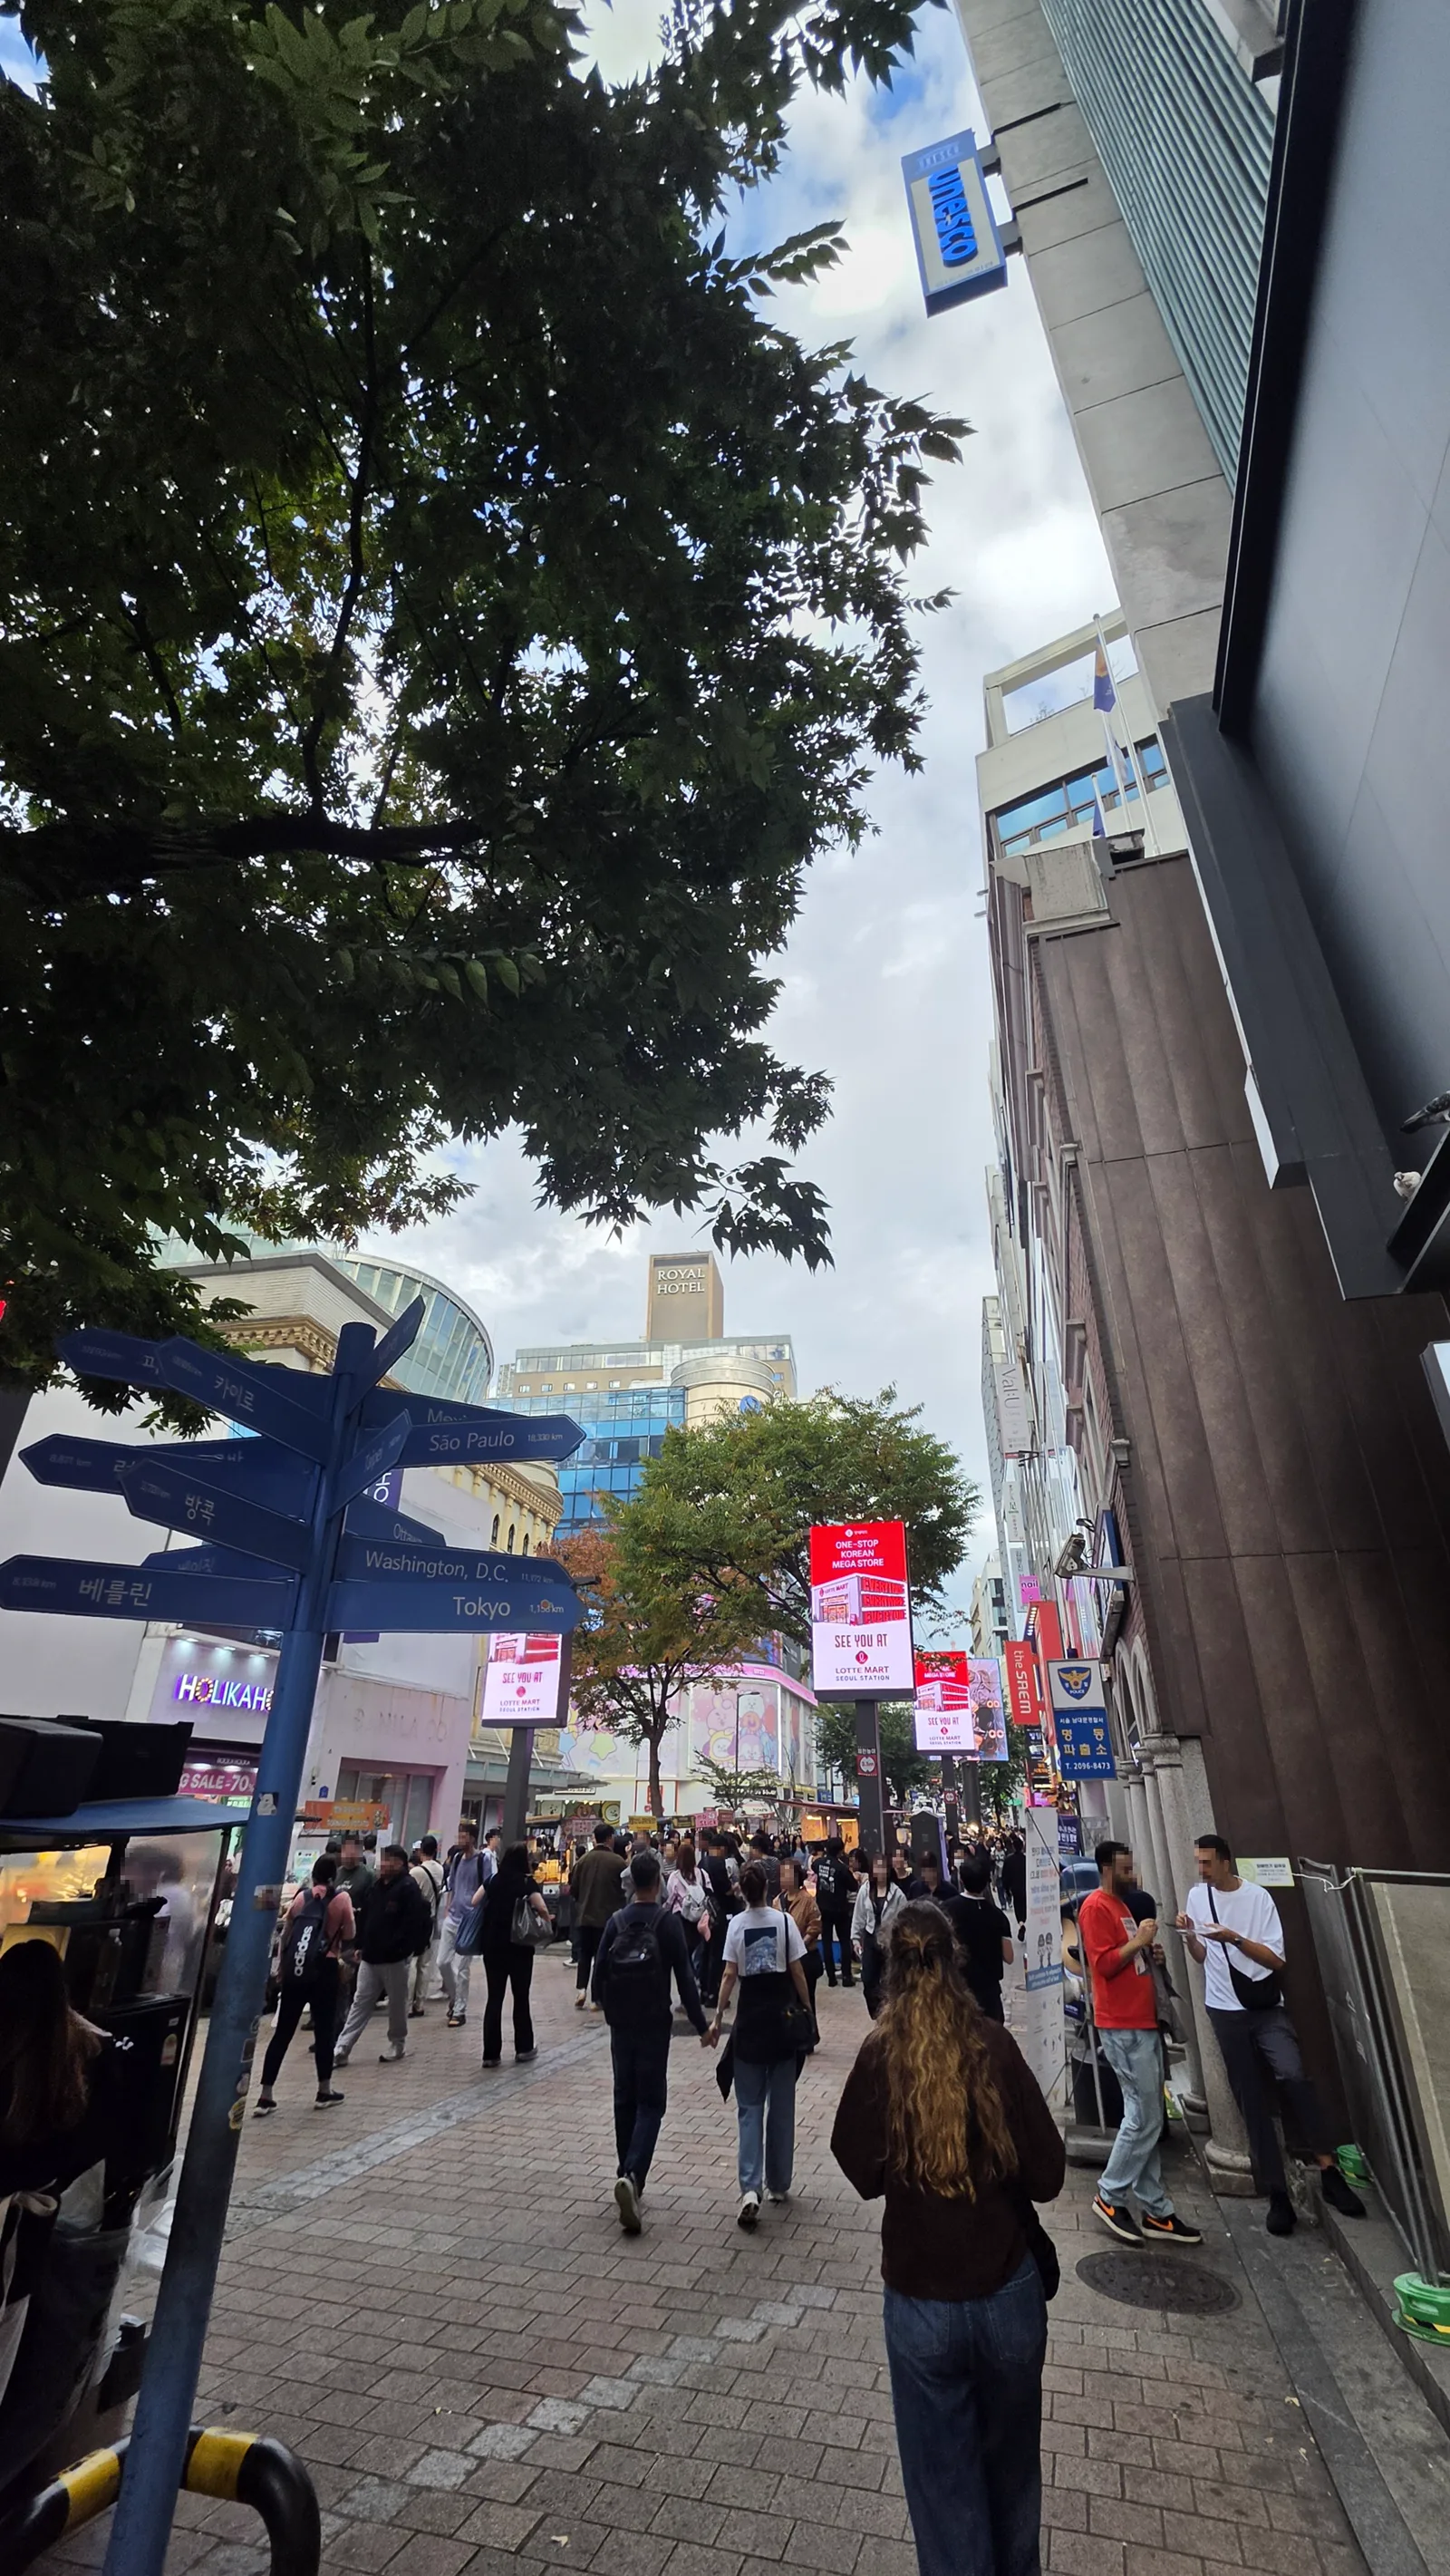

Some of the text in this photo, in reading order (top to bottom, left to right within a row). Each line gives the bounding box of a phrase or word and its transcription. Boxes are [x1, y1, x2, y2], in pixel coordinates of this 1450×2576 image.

[658, 1268, 705, 1281] ROYAL
[657, 1282, 705, 1294] HOTEL
[213, 1374, 255, 1412] 카이로
[430, 1433, 460, 1451] São
[467, 1430, 515, 1448] Paulo
[185, 1494, 216, 1525] 방콕
[836, 1539, 879, 1549] ONE-STOP
[841, 1550, 875, 1558] KOREAN
[365, 1550, 468, 1580] Washington,
[476, 1562, 508, 1583] D.C.
[857, 1558, 884, 1567] STORE
[1021, 1580, 1039, 1588] nail
[78, 1578, 153, 1607] 베를린
[453, 1596, 510, 1621] Tokyo
[551, 1603, 565, 1613] km
[835, 1633, 887, 1648] SEE YOU AT
[502, 1671, 543, 1683] SEE YOU AT
[1013, 1650, 1032, 1715] the SAEM
[179, 1673, 275, 1711] HOLIKAH
[928, 1717, 960, 1726] SEE YOU AT
[1074, 1761, 1111, 1770] 2096-8473
[190, 1773, 224, 1790] SALE
[295, 1926, 313, 1976] adidas
